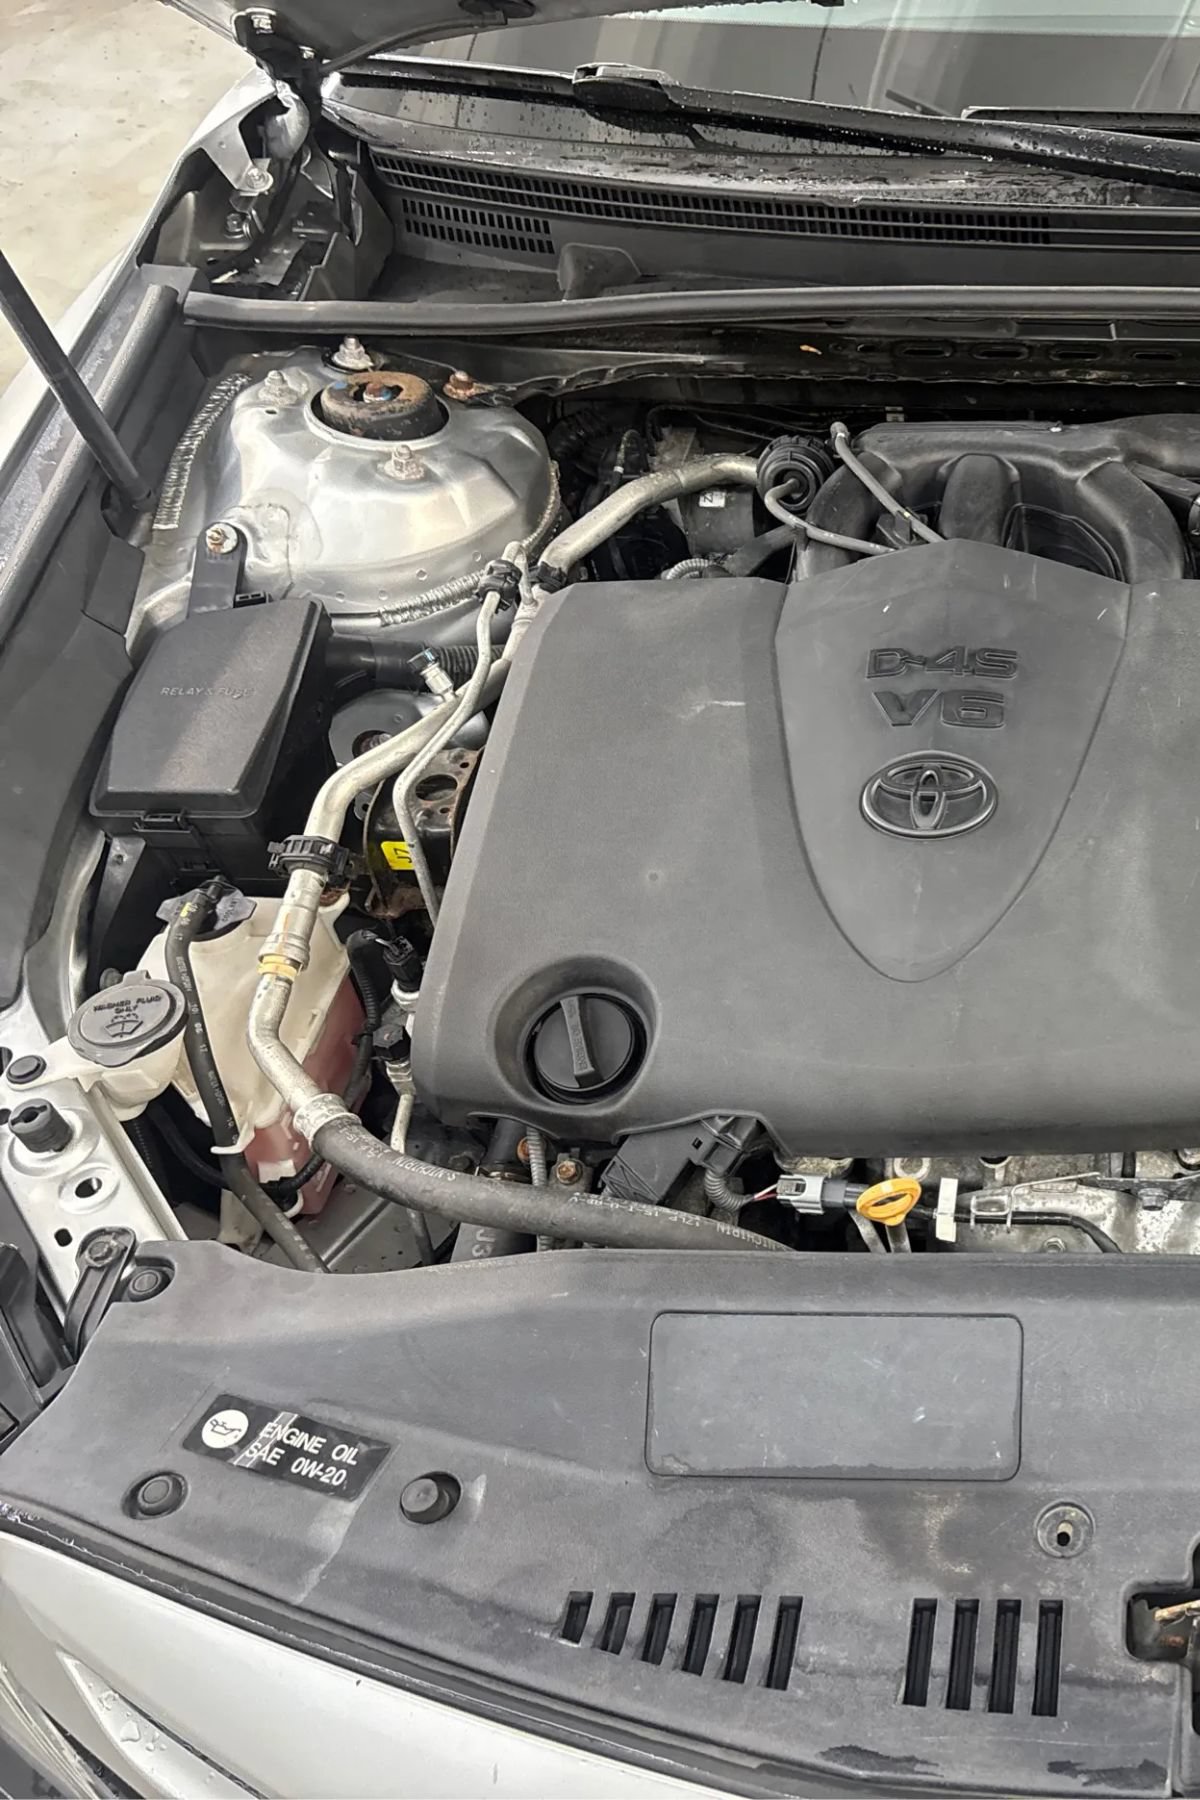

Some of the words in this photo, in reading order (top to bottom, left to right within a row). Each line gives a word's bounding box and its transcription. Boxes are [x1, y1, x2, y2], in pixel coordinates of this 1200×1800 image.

[160, 687, 204, 696] RELAY
[872, 688, 1006, 729] V6
[246, 1443, 285, 1465] SAE
[291, 1457, 347, 1486] 0W-20
[259, 1422, 327, 1454] ENGINE
[331, 1443, 358, 1465] OIL
